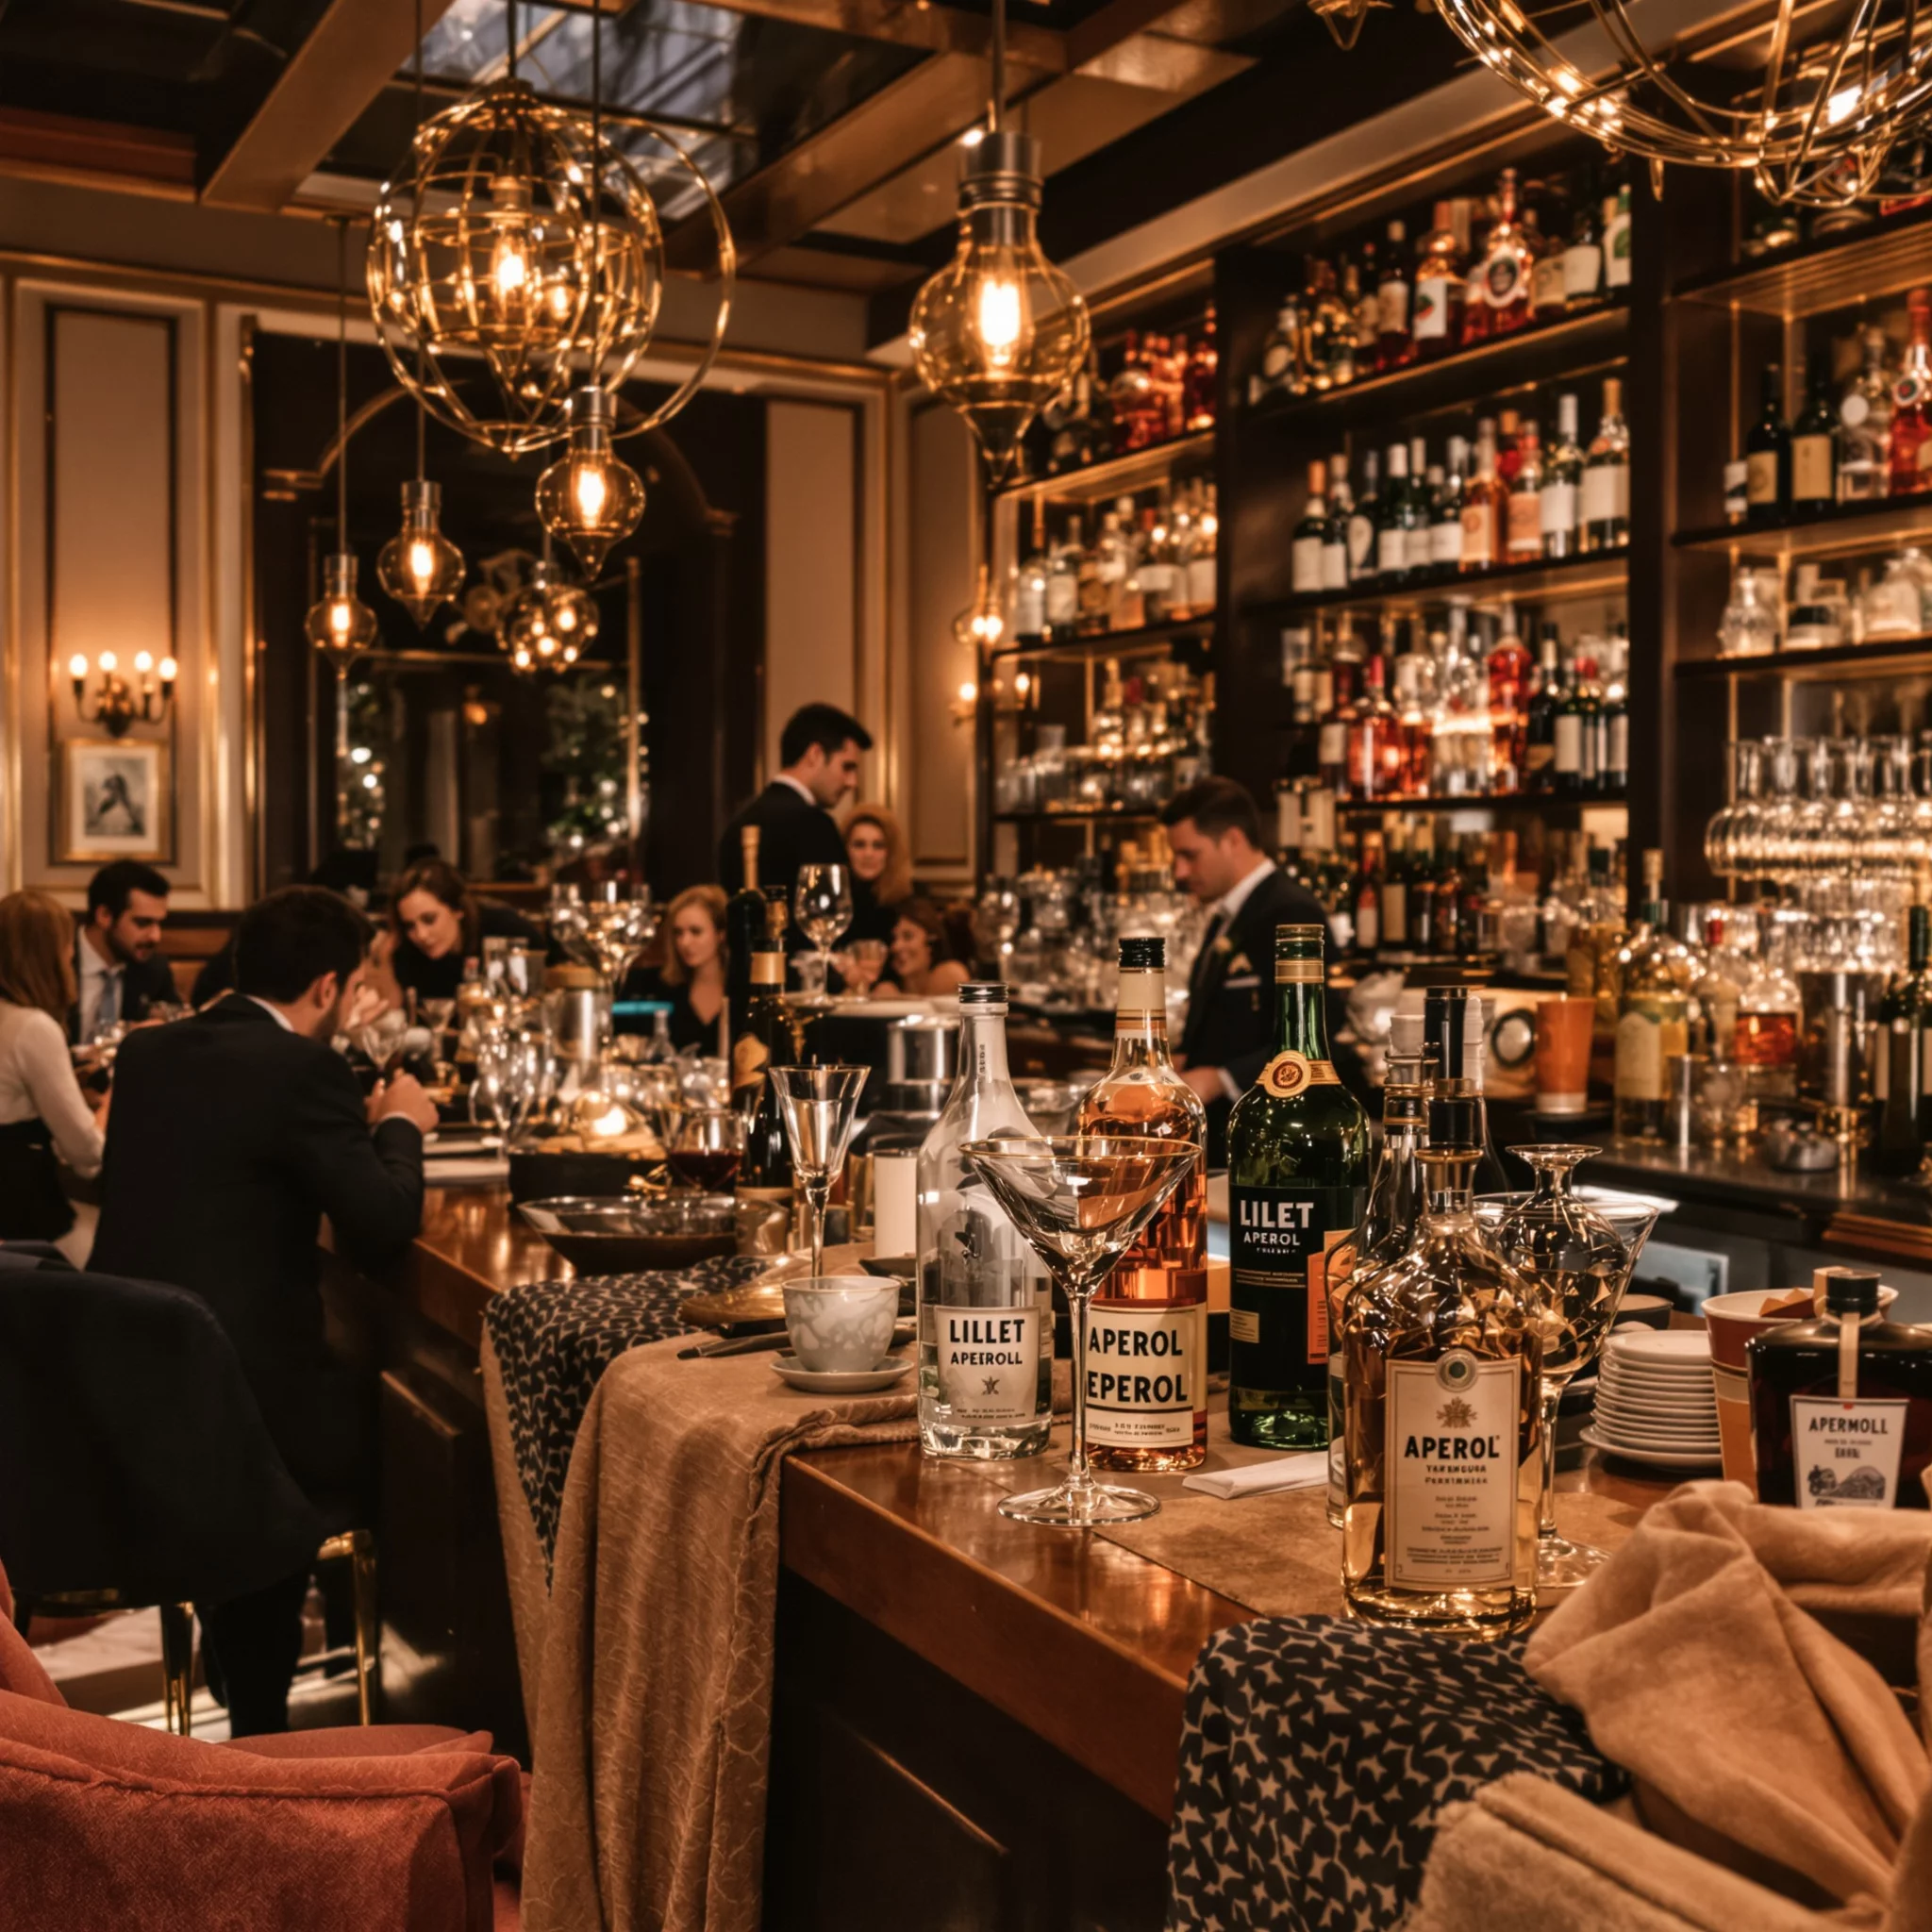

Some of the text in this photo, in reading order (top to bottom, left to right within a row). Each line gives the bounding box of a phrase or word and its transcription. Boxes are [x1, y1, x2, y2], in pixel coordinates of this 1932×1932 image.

[1240, 1200, 1314, 1228] LILET
[1243, 1231, 1301, 1246] APEROL
[950, 1319, 1024, 1343] LILLET
[1089, 1326, 1183, 1357] APEROL
[1088, 1370, 1188, 1403] EPEROL
[1808, 1417, 1888, 1434] APERMOLL
[1404, 1435, 1500, 1459] APEROL
